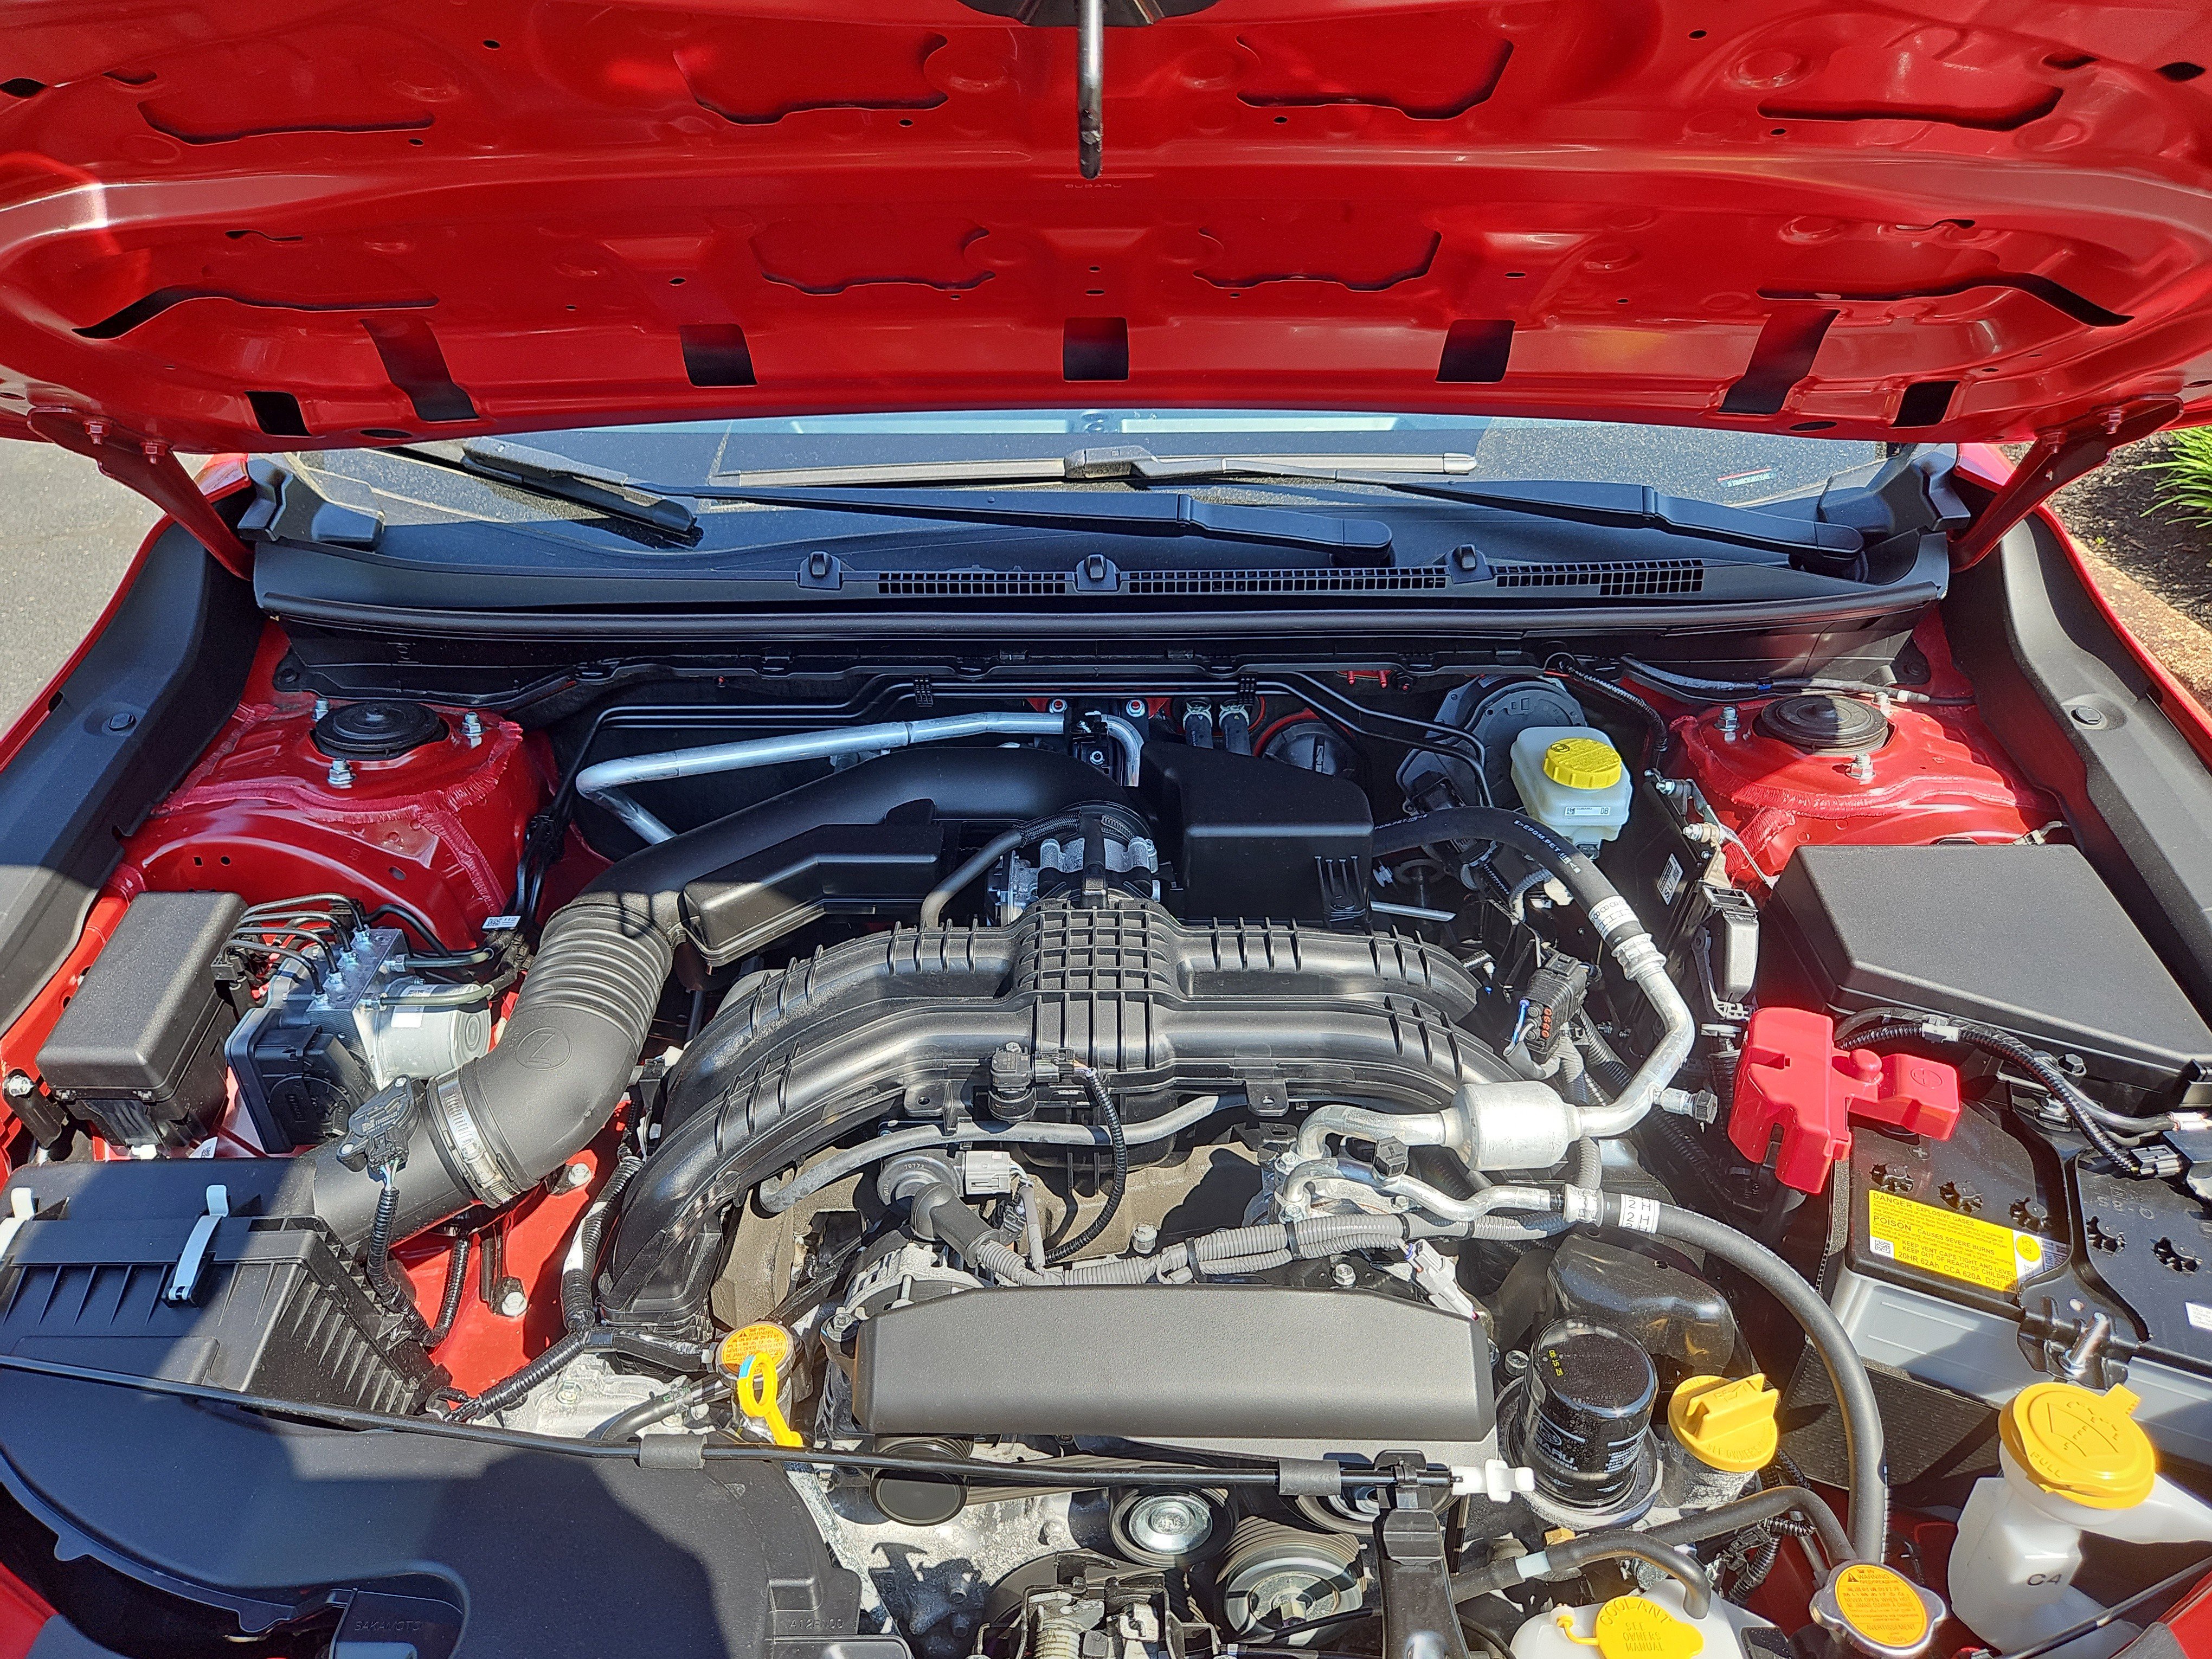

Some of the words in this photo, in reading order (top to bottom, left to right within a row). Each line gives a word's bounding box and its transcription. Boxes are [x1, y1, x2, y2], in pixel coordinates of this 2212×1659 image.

[1629, 1199, 1636, 1208] 2
[1642, 1202, 1651, 1211] H
[1873, 1192, 1912, 1209] DANGER
[1916, 1205, 1951, 1220] EXPLOSIVE
[1952, 1216, 1974, 1226] GASES
[1626, 1212, 1635, 1222] 2
[1639, 1214, 1649, 1225] H
[1873, 1211, 1895, 1221] instruction
[1873, 1203, 1888, 1211] Always
[1981, 1233, 1997, 1242] charge
[1963, 1224, 1978, 1232] battery
[1874, 1215, 1911, 1232] POISON
[1917, 1228, 1943, 1240] CAUSES
[1945, 1236, 1971, 1248] SEVERE
[1972, 1244, 1995, 1255] BURNS
[1900, 1214, 1915, 1223] cables
[1921, 1220, 1935, 1229] adjust
[1947, 1228, 1974, 1239] connections
[1975, 1236, 1991, 1245] without
[1898, 1232, 1917, 1241] accident
[1936, 1239, 1953, 1248] contact
[1902, 1239, 1919, 1249] KEEP
[1920, 1244, 1937, 1255] VENT
[1939, 1250, 1957, 1260] CAPS
[1958, 1256, 1977, 1266] TIGHT
[1979, 1262, 1992, 1271] AND
[1995, 1266, 2015, 1277] LEVEL
[1898, 1250, 1918, 1263] 20HR
[1920, 1257, 1939, 1269] 62Ah
[1944, 1264, 1960, 1276] CCA
[1963, 1269, 1982, 1282] 620A
[1902, 1245, 1919, 1255] KEEP
[1921, 1250, 1934, 1259] OUT
[1936, 1255, 1945, 1263] OF
[1946, 1258, 1969, 1270] REACH
[1971, 1265, 1979, 1273] OF
[1982, 1268, 2016, 1284] CHILDREN
[1552, 1359, 1559, 1367] 15
[2027, 1573, 2061, 1587] C4
[1599, 1598, 1672, 1625] COOLANT
[355, 1620, 422, 1631] SAKAMOTO
[1625, 1622, 1645, 1631] SEE
[1623, 1631, 1661, 1641] OWNERS
[1625, 1642, 1665, 1652] MANUAL
